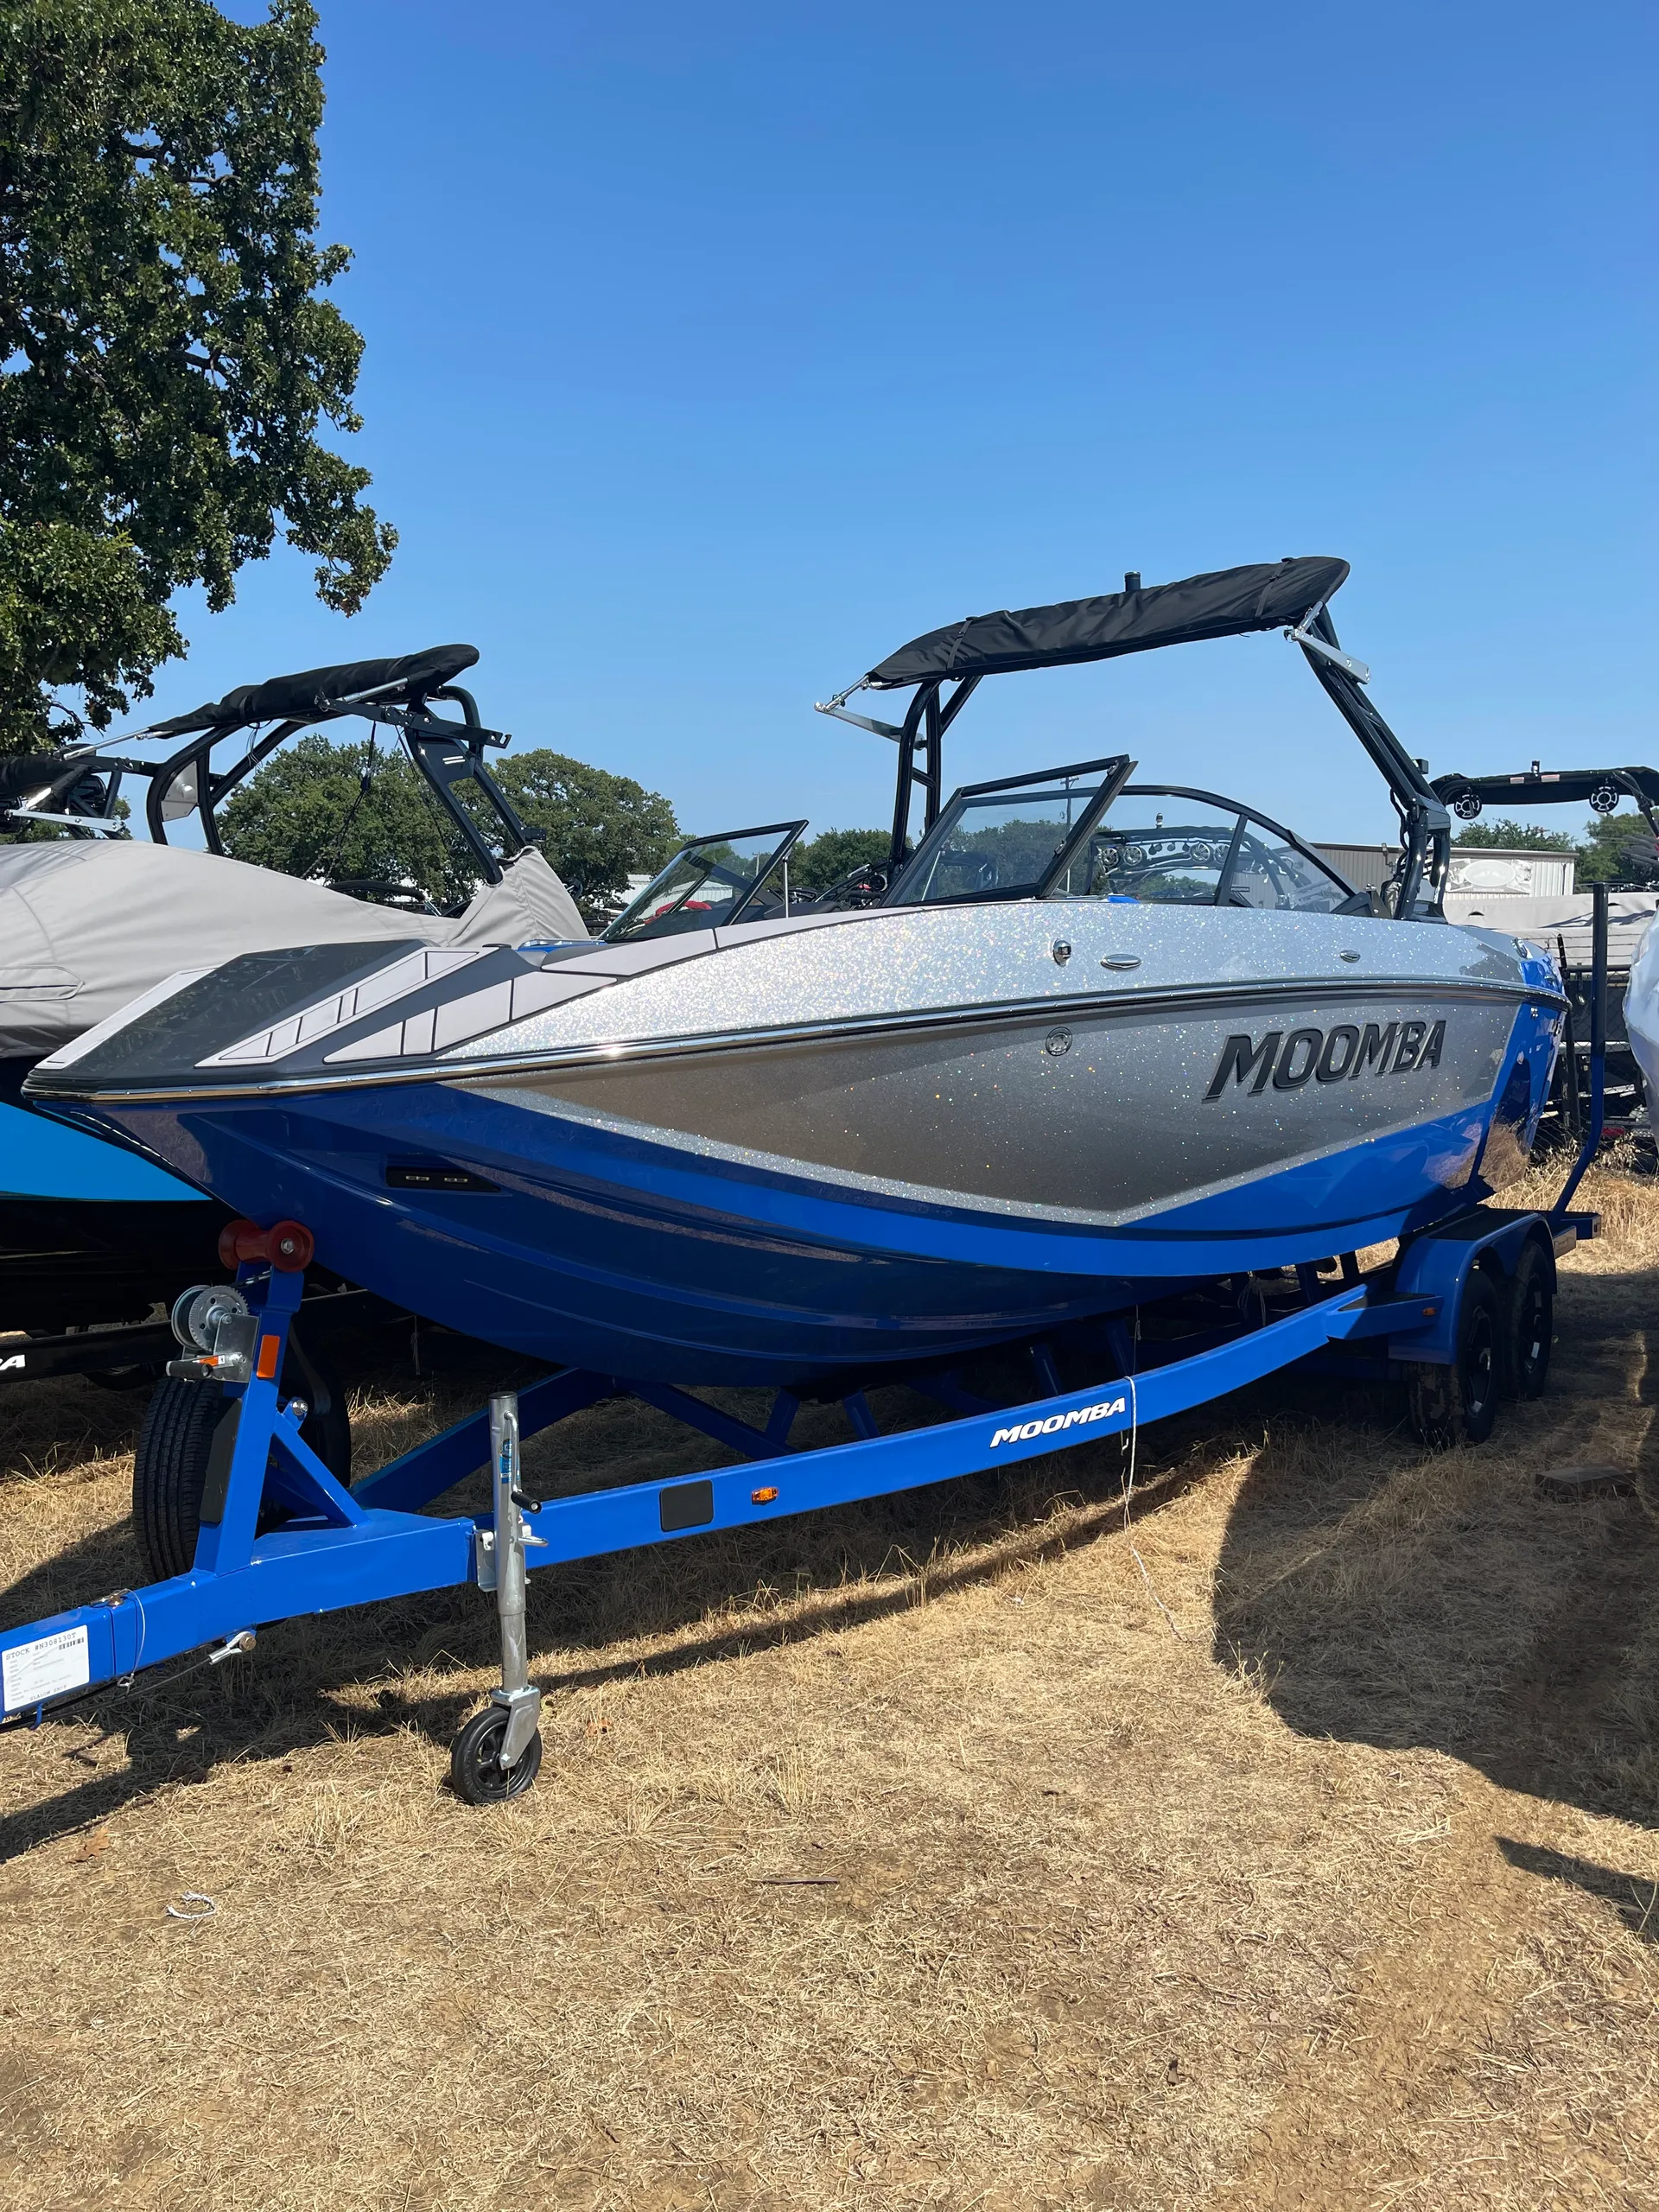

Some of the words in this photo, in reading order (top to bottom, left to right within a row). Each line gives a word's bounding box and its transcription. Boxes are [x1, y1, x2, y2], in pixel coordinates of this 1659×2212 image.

[1202, 1020, 1446, 1103] MOOMBA
[0, 1354, 26, 1371] A
[989, 1396, 1126, 1448] MOOMBA
[6, 1648, 30, 1660] STOCK
[35, 1632, 76, 1650] #N308130T
